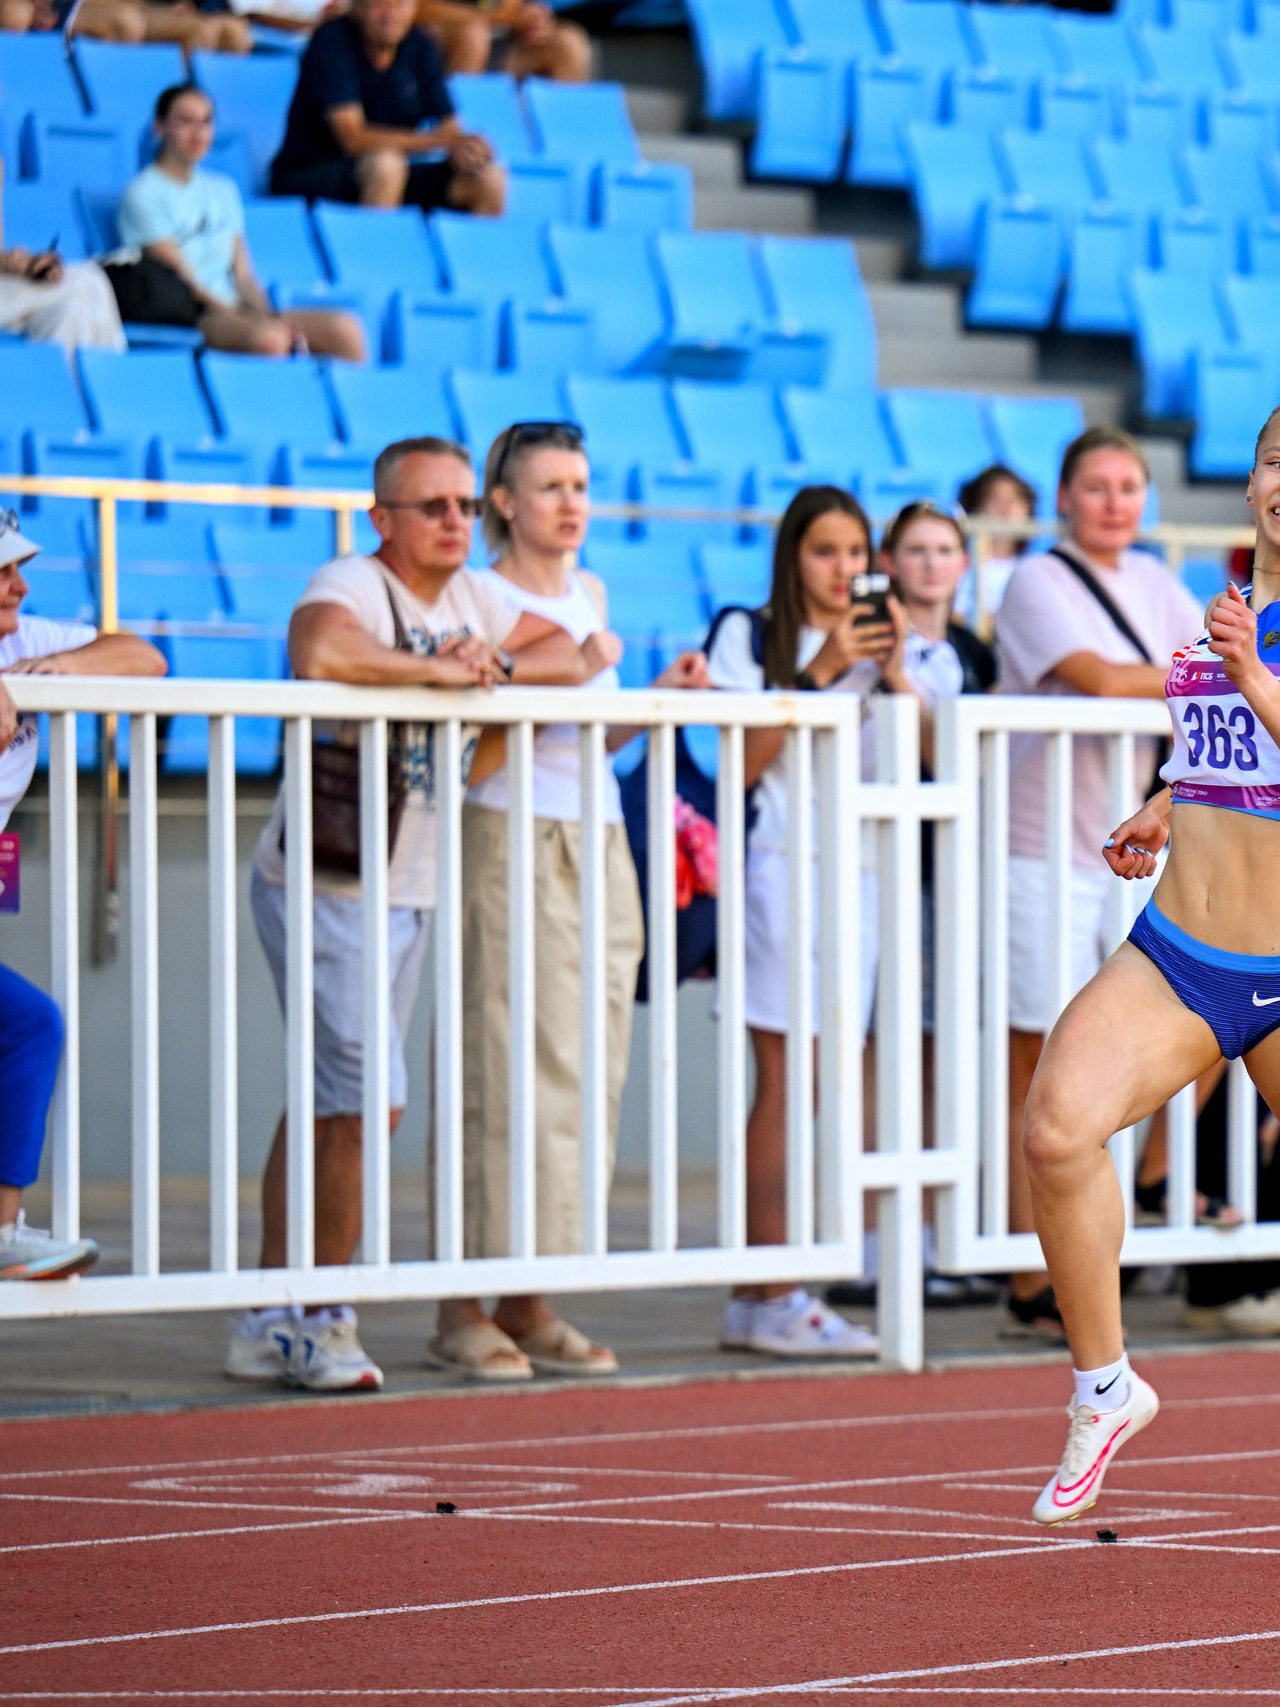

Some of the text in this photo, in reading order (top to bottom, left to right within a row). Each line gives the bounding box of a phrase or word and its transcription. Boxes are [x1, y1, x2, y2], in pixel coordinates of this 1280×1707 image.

[1200, 672, 1214, 680] ПСБ
[1183, 702, 1259, 771] 363
[127, 1473, 581, 1498] 8
[766, 1501, 1231, 1528] 7
